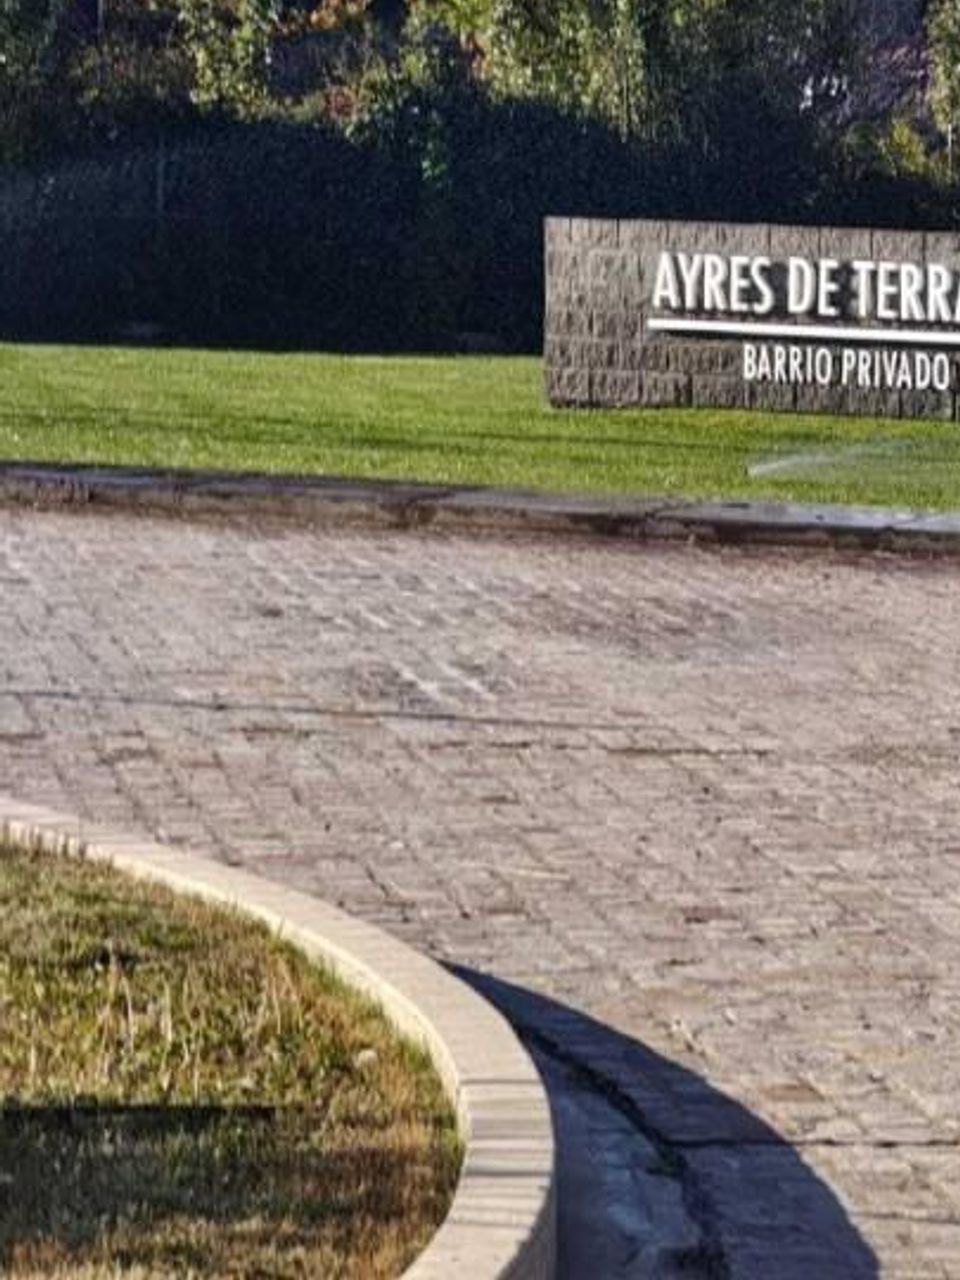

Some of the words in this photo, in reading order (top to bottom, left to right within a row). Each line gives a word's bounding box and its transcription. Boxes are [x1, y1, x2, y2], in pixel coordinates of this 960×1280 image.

[652, 251, 774, 313] AYRES
[787, 256, 840, 316] DE
[743, 343, 832, 384] BARRIO
[841, 347, 950, 391] PRIVADO
